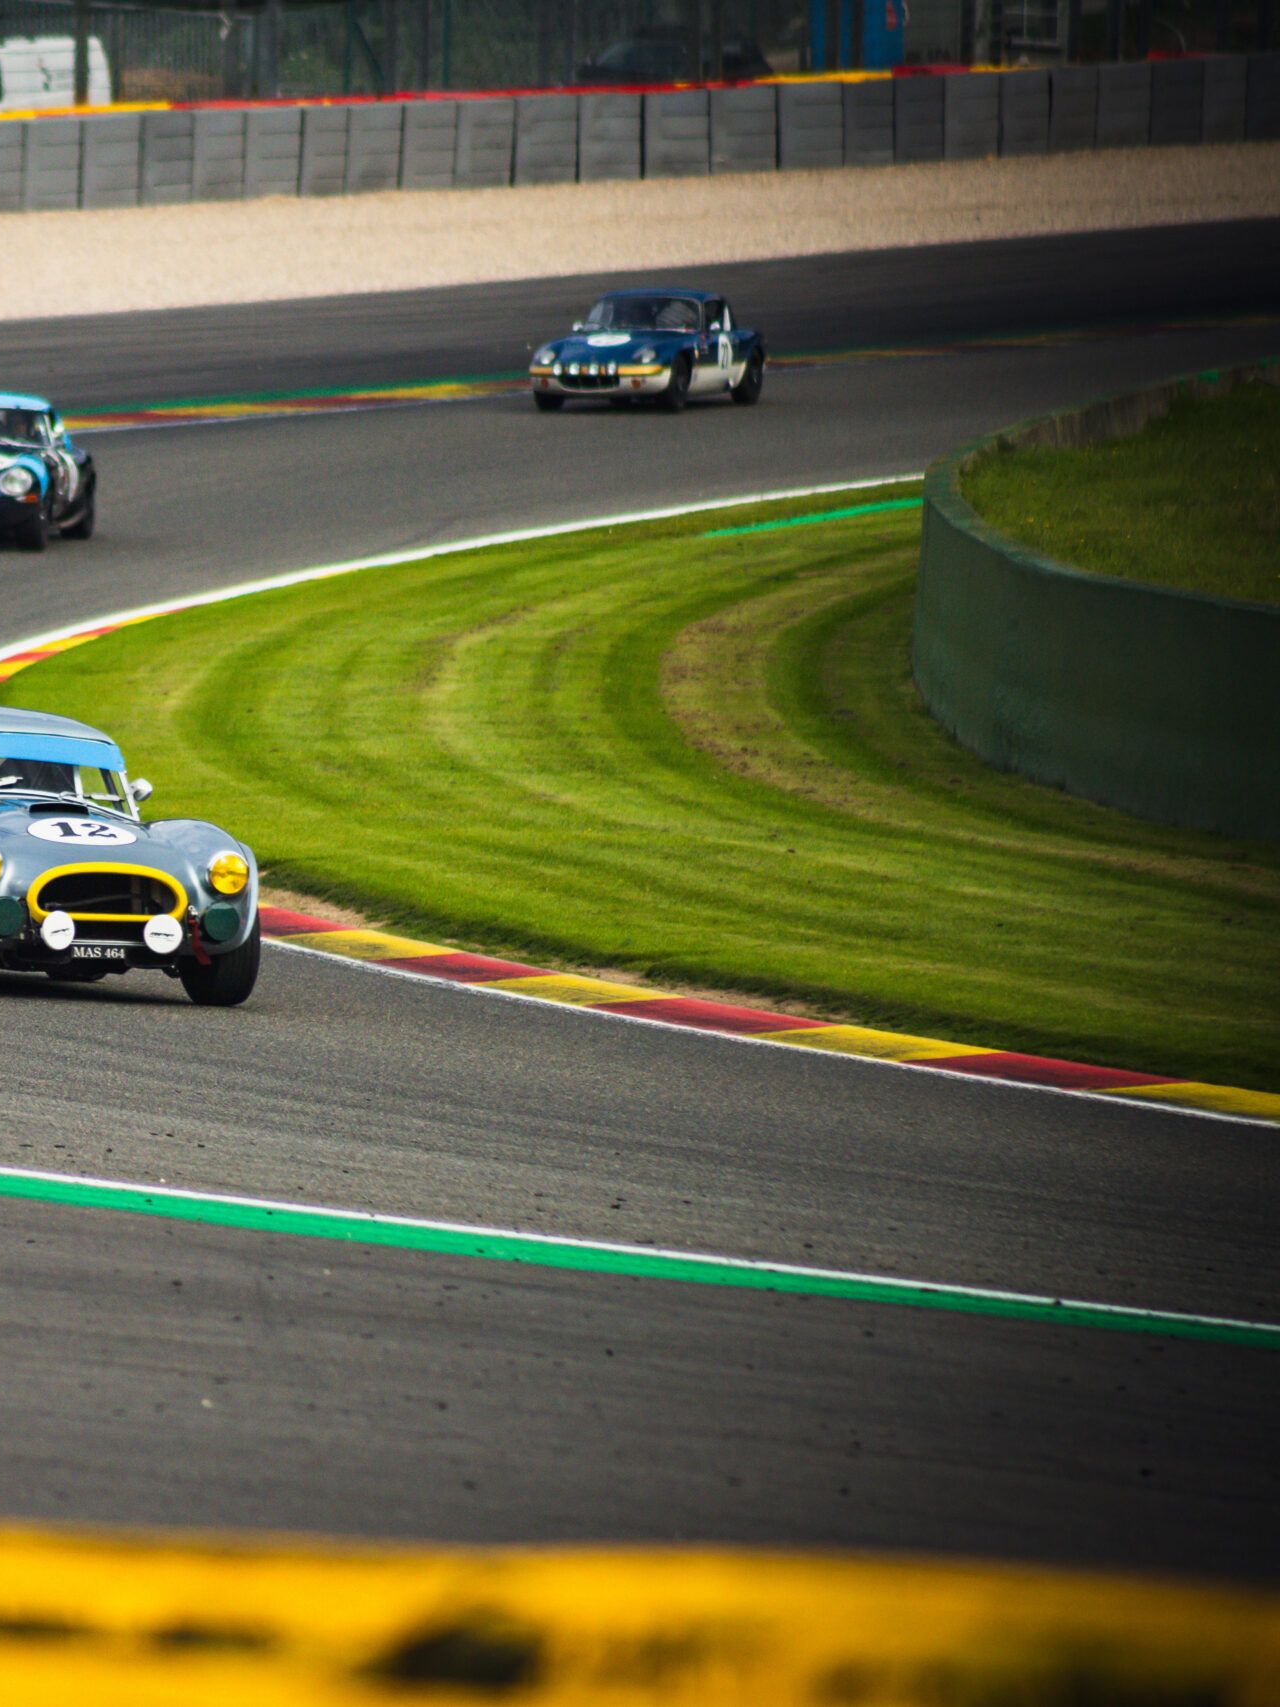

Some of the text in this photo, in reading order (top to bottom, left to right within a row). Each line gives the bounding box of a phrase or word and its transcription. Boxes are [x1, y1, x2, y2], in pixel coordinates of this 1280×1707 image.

[51, 822, 117, 838] 12
[73, 946, 126, 959] MAS 464
